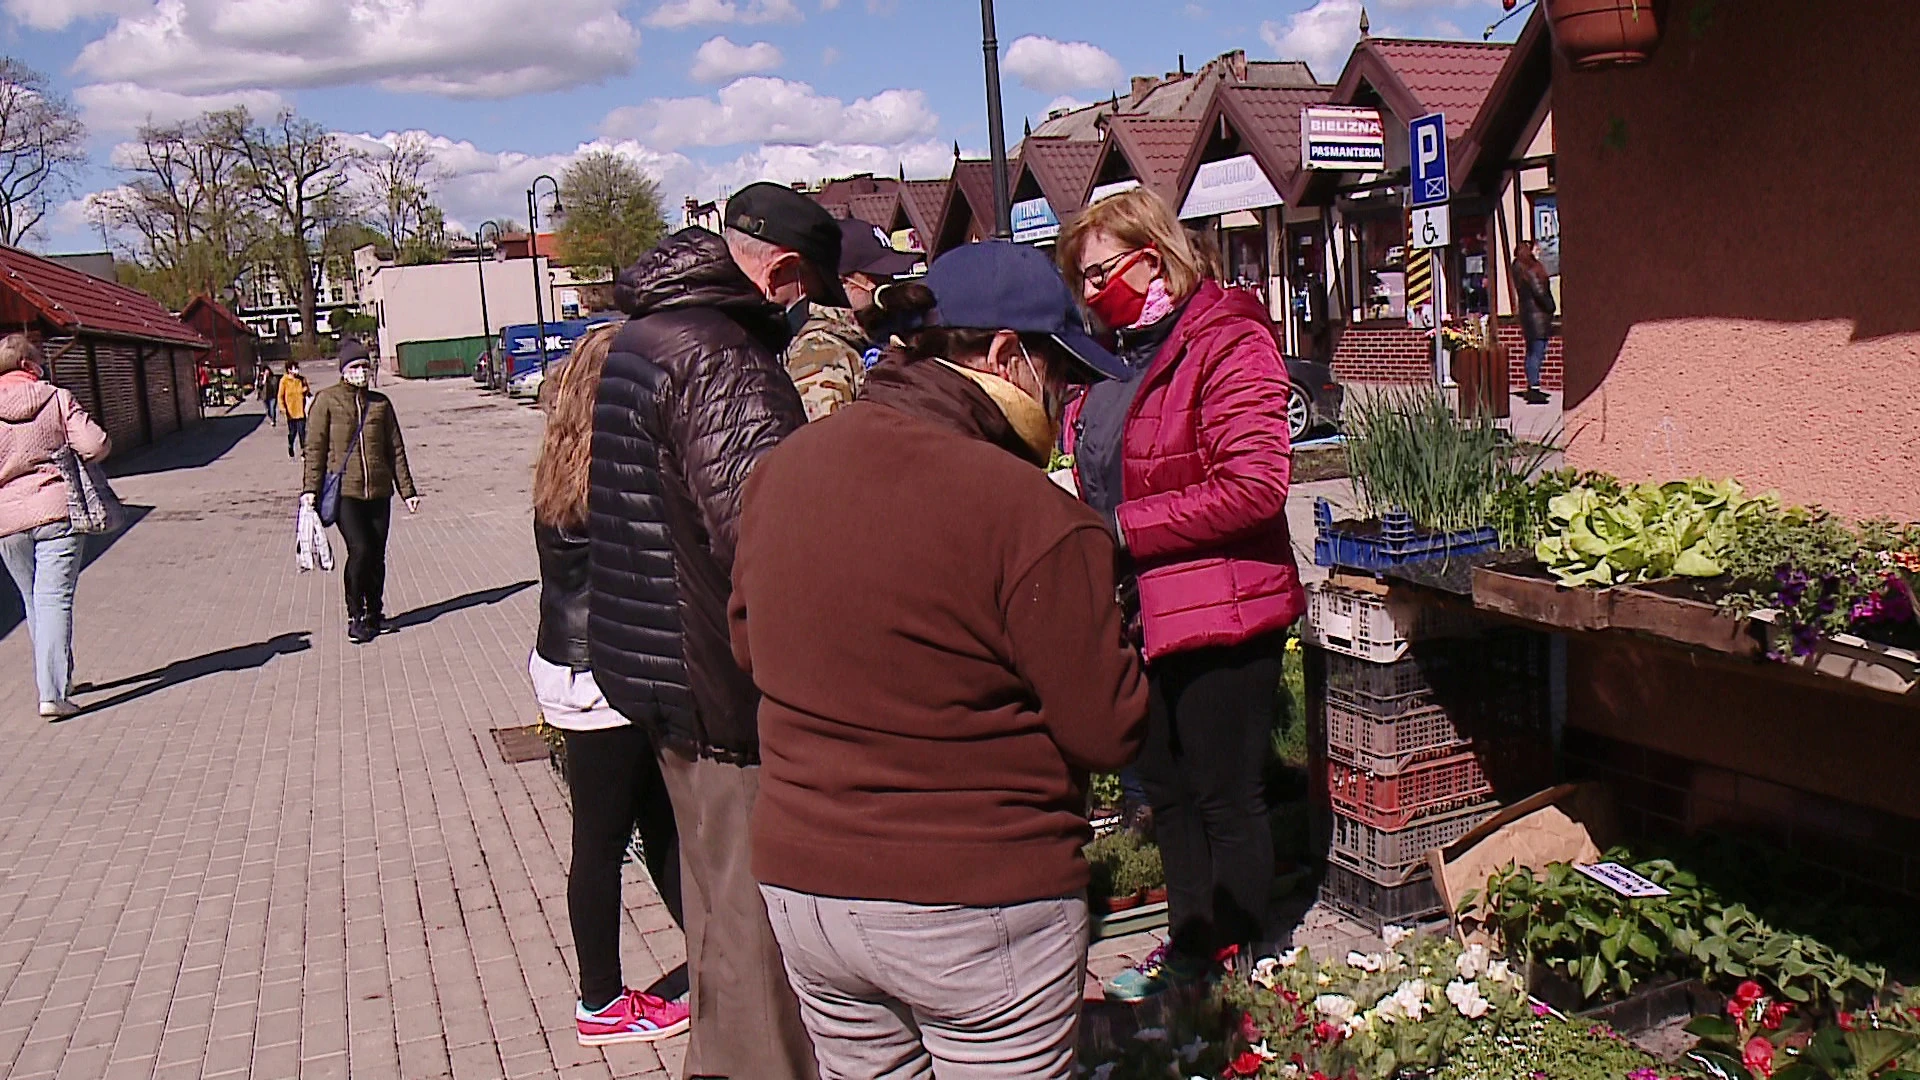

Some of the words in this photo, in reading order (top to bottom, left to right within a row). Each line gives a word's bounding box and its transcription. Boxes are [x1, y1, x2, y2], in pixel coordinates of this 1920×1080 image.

[1310, 119, 1381, 134] BIELIZNA
[1311, 145, 1382, 159] PASMANTERIA
[1417, 124, 1439, 180] P
